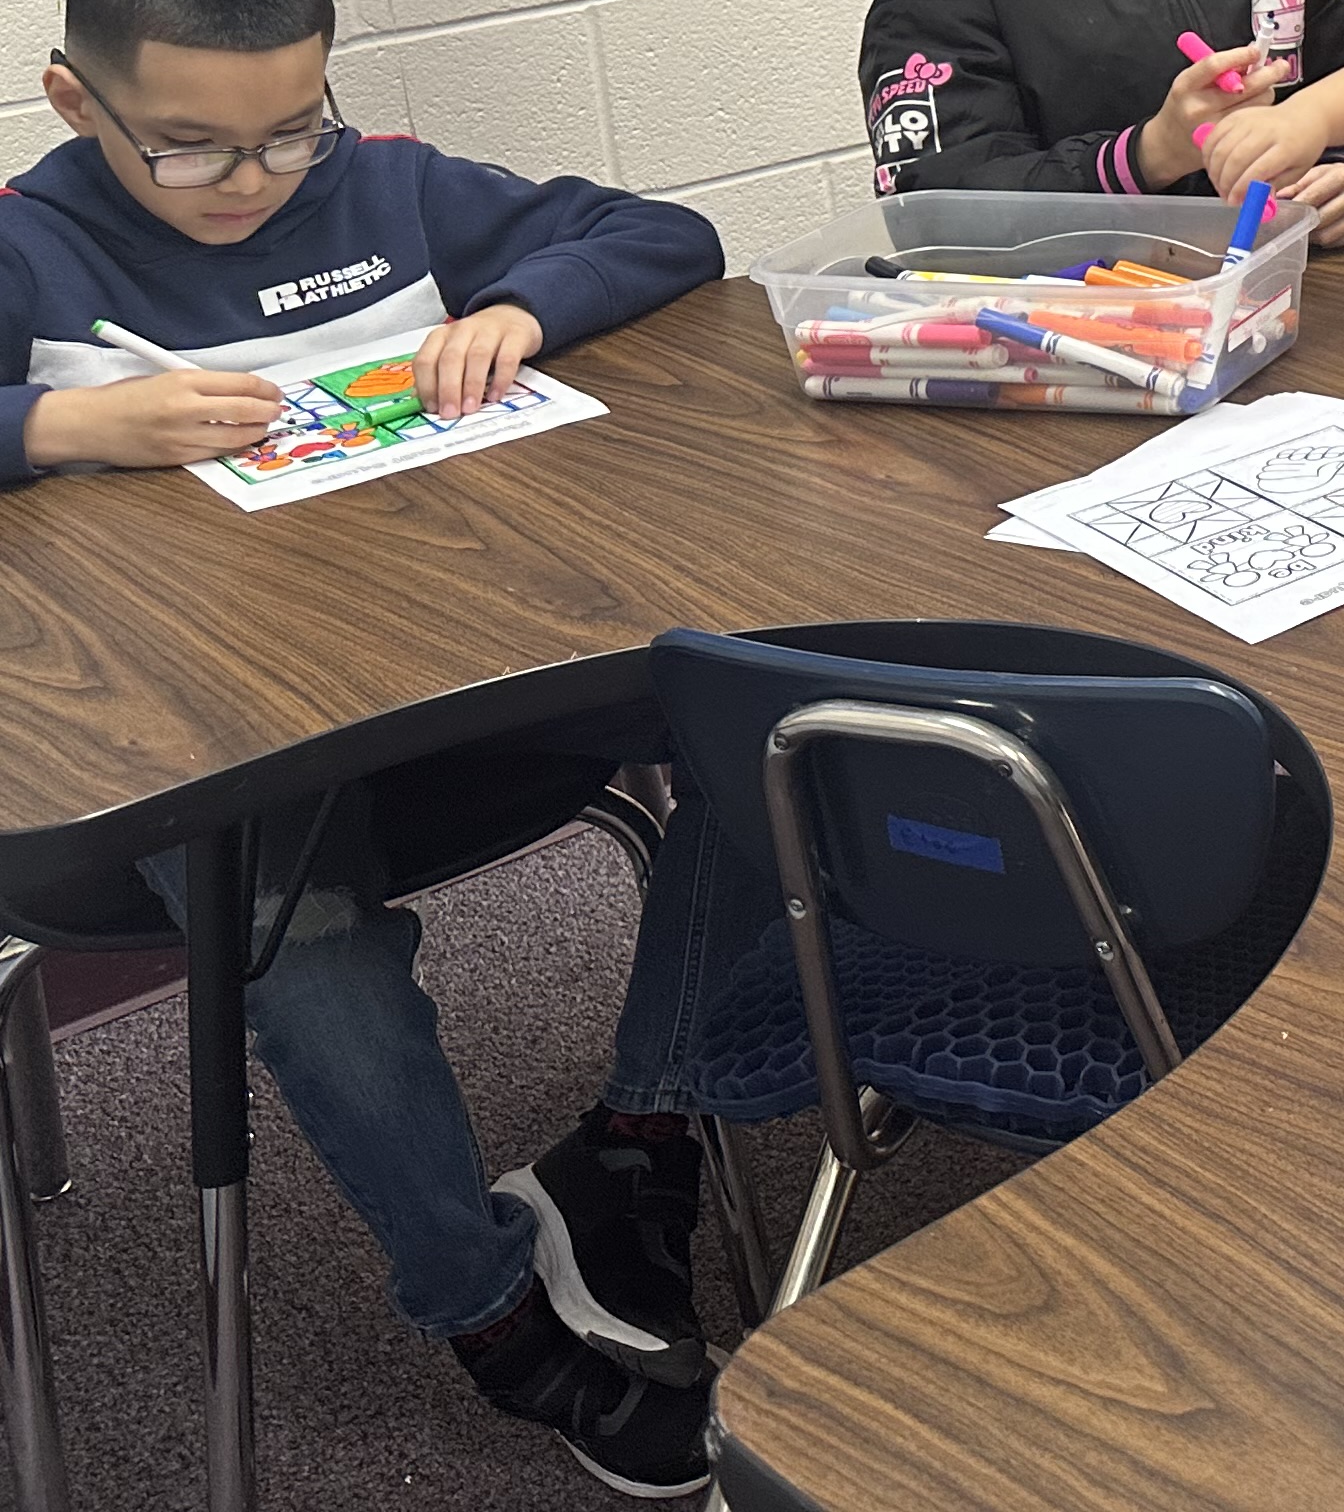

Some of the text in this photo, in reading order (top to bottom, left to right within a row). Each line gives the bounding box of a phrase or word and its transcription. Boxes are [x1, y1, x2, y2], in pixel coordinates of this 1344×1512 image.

[881, 78, 926, 104] SPEED
[299, 254, 386, 291] RUSSELL
[304, 262, 392, 305] ATHLETIC
[1190, 524, 1270, 555] kind
[1268, 559, 1317, 579] be
